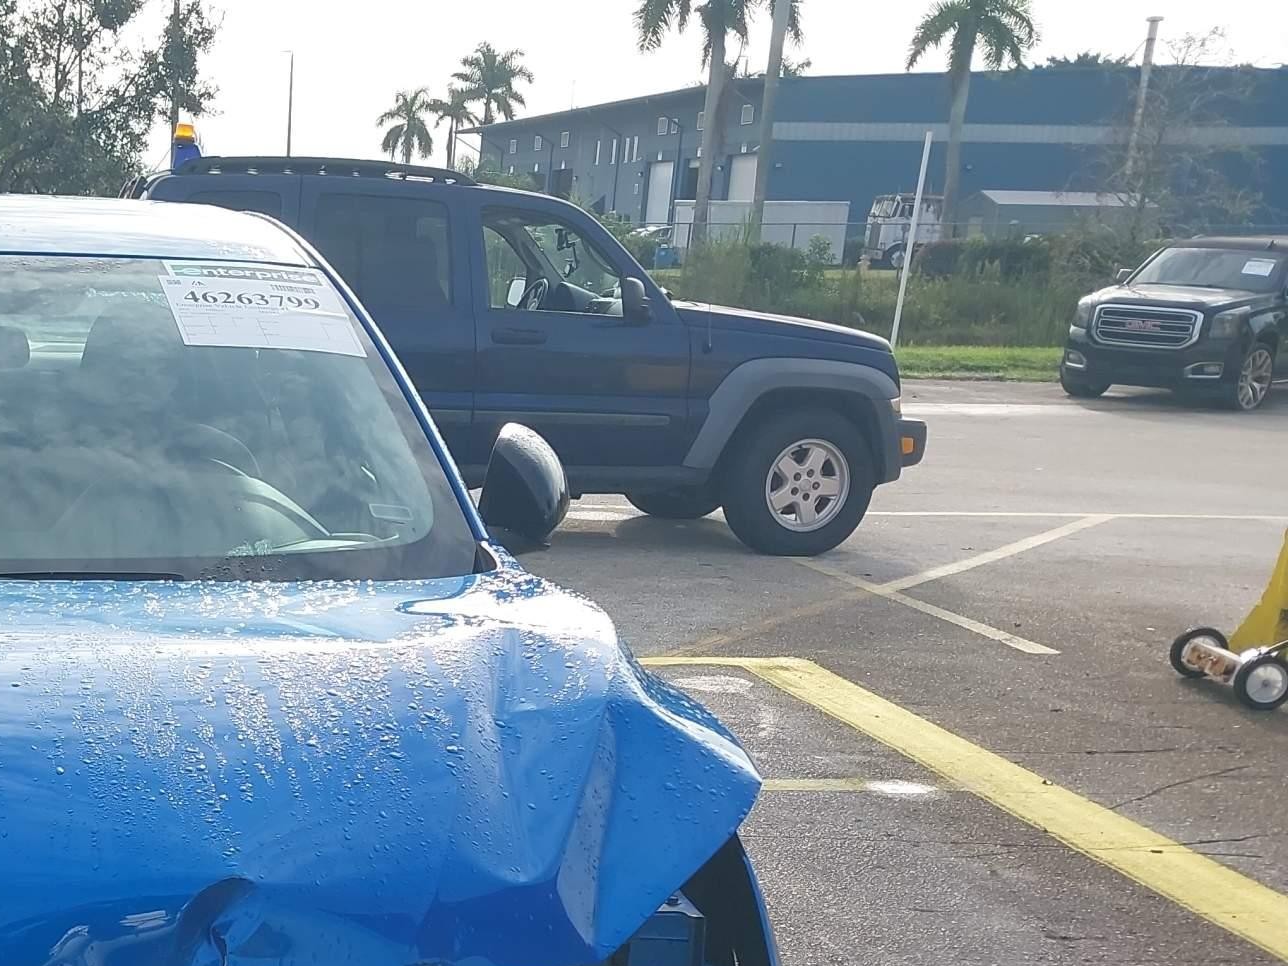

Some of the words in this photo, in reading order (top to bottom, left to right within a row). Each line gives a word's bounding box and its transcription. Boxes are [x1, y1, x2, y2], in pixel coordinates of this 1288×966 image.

[175, 266, 319, 284] enterprise
[183, 289, 321, 311] 46263799
[1125, 319, 1160, 331] GMC
